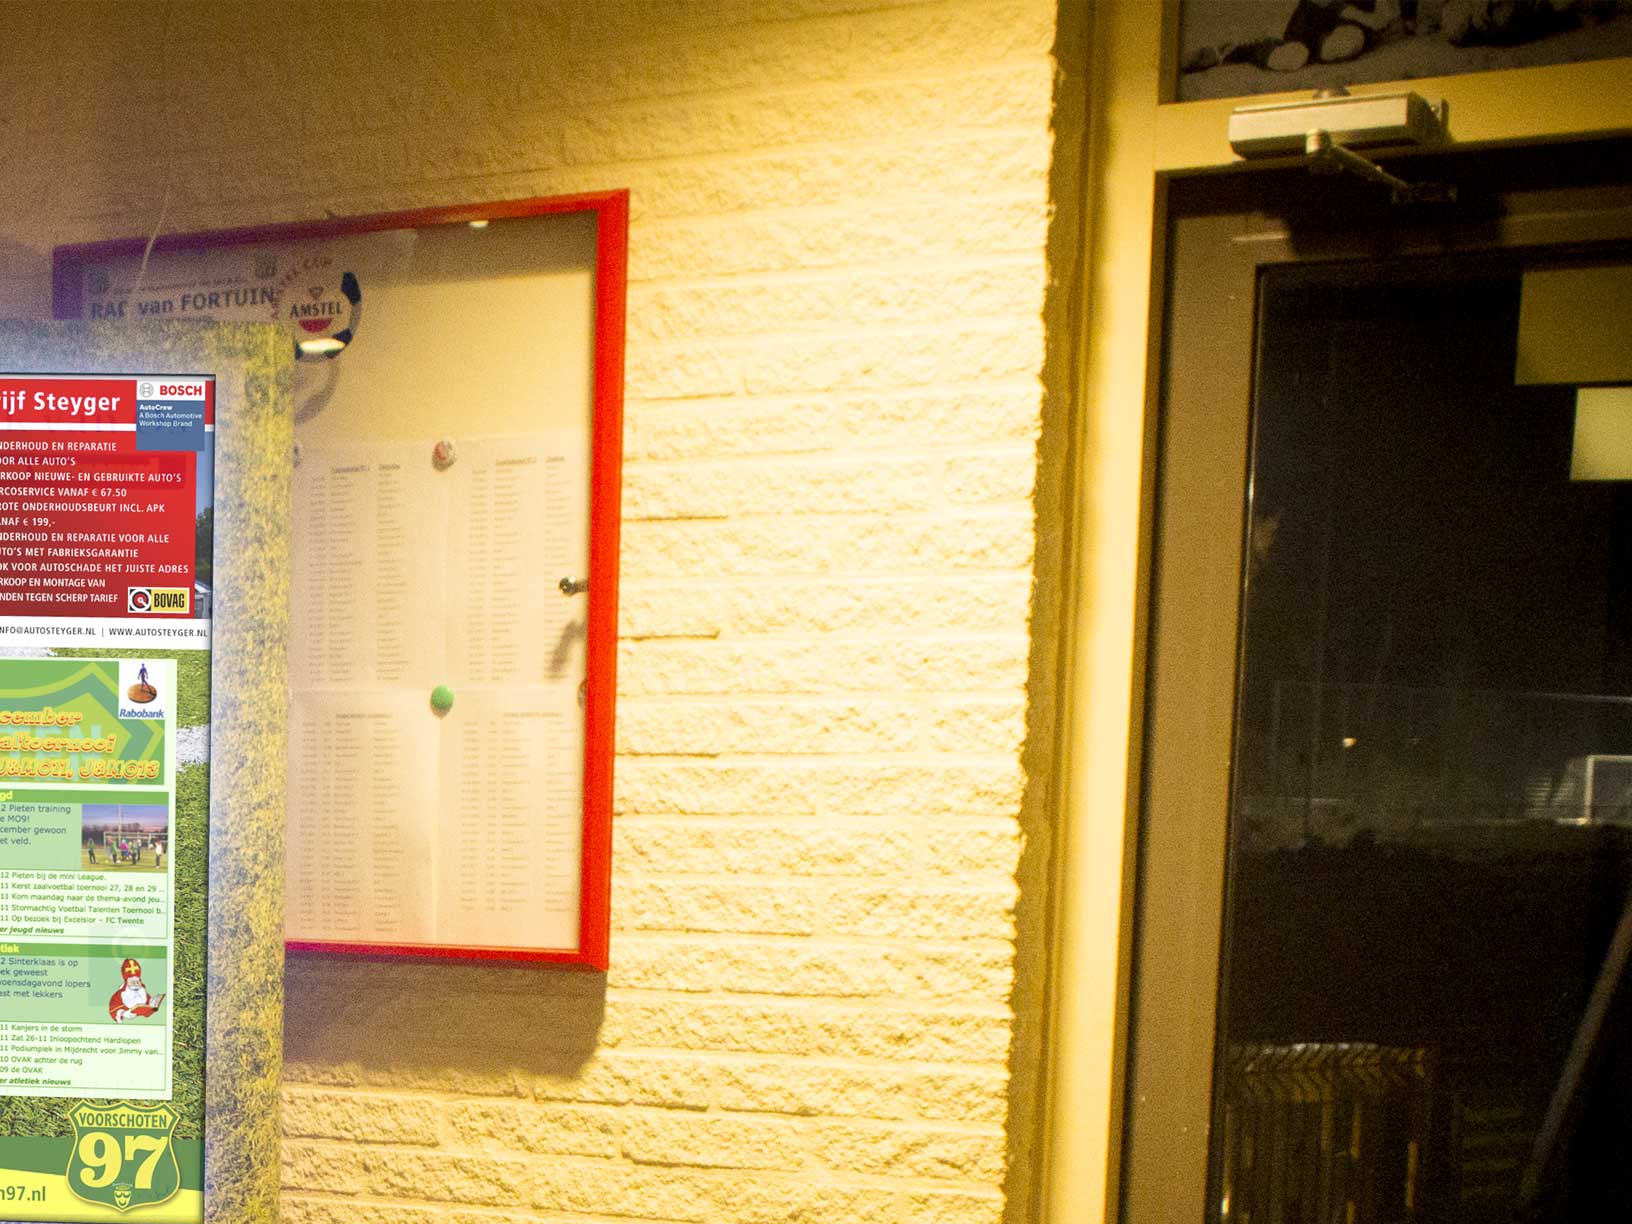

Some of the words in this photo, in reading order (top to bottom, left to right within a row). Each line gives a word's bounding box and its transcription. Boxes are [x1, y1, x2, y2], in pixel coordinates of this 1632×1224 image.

[180, 287, 275, 311] FORTUIN
[289, 301, 343, 318] AMSTEL
[160, 385, 202, 396] BOSCH
[33, 392, 120, 415] Steyger
[139, 420, 172, 428] Workshop
[52, 442, 64, 450] EN
[68, 442, 117, 451] REPARATIE
[18, 457, 40, 466] ALLE
[42, 457, 76, 466] AUTO'S
[34, 472, 75, 481] NIEUWE-
[78, 473, 91, 481] EN
[94, 473, 145, 482] GEBRUIKTE
[147, 473, 182, 482] AUTO'S
[58, 488, 89, 496] VANAF
[92, 489, 98, 497] €
[100, 489, 127, 497] 67.50
[22, 502, 117, 512] ONDERHOUDSBEURT
[119, 503, 144, 513] INCL.
[146, 504, 165, 513] APK
[23, 518, 29, 526] €
[32, 518, 56, 527] 199,-
[51, 533, 64, 542] EN
[67, 533, 116, 543] REPARATIE
[118, 534, 145, 543] VOOR
[147, 534, 169, 543] ALLE
[25, 548, 44, 557] MET
[47, 548, 139, 558] FABRIEKSGARANTIE
[11, 563, 37, 572] VOOR
[40, 563, 102, 573] AUTOSCHADE
[105, 564, 122, 573] HET
[125, 564, 155, 573] JUISTE
[158, 564, 189, 574] ADRES
[29, 578, 41, 587] EN
[43, 578, 86, 587] MONTAGE
[87, 578, 106, 587] VAN
[25, 593, 53, 601] TEGEN
[55, 593, 88, 602] SCHERP
[90, 594, 118, 603] TARIEF
[153, 593, 185, 609] BOVAG
[109, 628, 208, 637] WWW.AUTOSTEYGER.NL
[119, 708, 164, 719] Rabobank
[9, 804, 36, 813] Pieten
[38, 804, 71, 815] training
[33, 826, 67, 836] gewoon
[10, 837, 31, 845] veld.
[8, 958, 56, 966] Sinterklaas
[67, 960, 79, 968] op
[13, 969, 48, 978] geweest
[65, 980, 91, 989] lopers
[13, 990, 30, 998] met
[32, 990, 63, 999] lekkers
[79, 1112, 167, 1129] VOORSCHOTEN
[78, 1131, 168, 1190] 97
